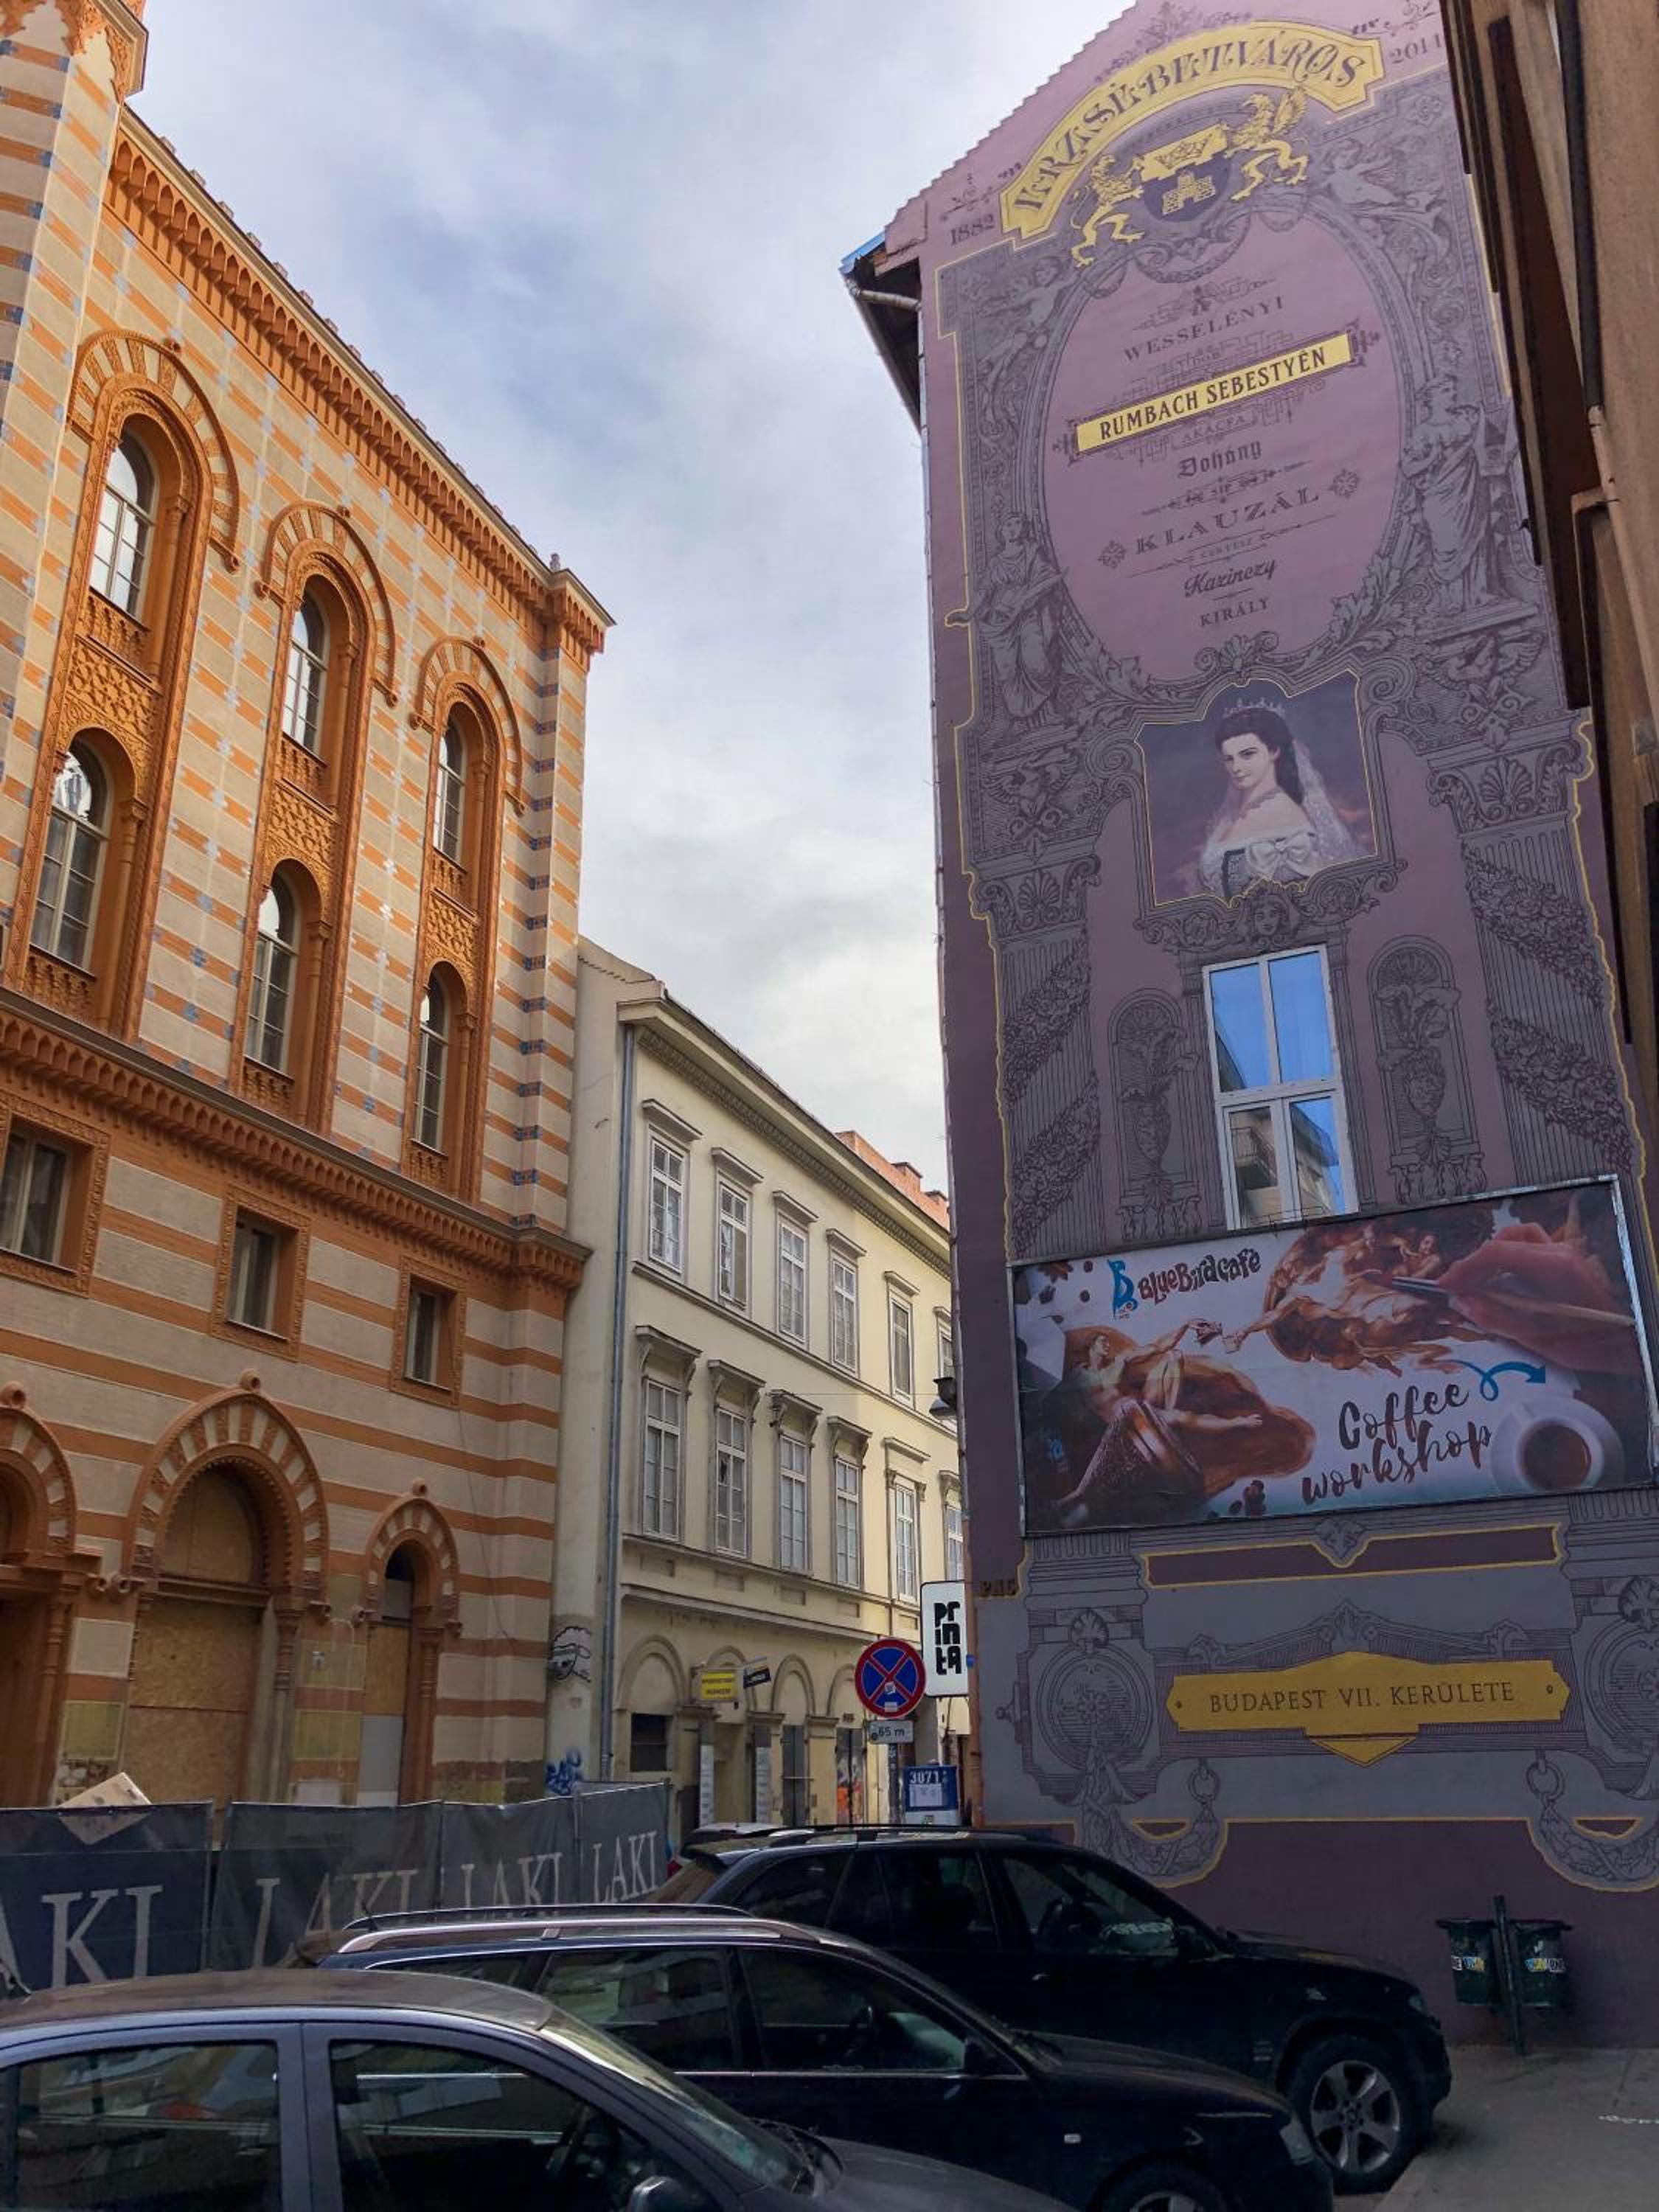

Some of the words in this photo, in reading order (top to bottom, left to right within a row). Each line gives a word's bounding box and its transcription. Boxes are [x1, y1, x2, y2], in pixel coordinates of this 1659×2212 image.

[1099, 389, 1199, 441] RUMBACH
[1206, 345, 1327, 404] SEBESTYÉN
[1134, 486, 1320, 556] KLAUZÁL
[1182, 558, 1279, 598] Kazinczy
[1338, 1383, 1470, 1450] Coffee
[1302, 1420, 1492, 1506] workshop
[1211, 1689, 1326, 1714] BUDAPEST
[1338, 1687, 1380, 1708] VII.
[592, 1831, 658, 1904] LAKI
